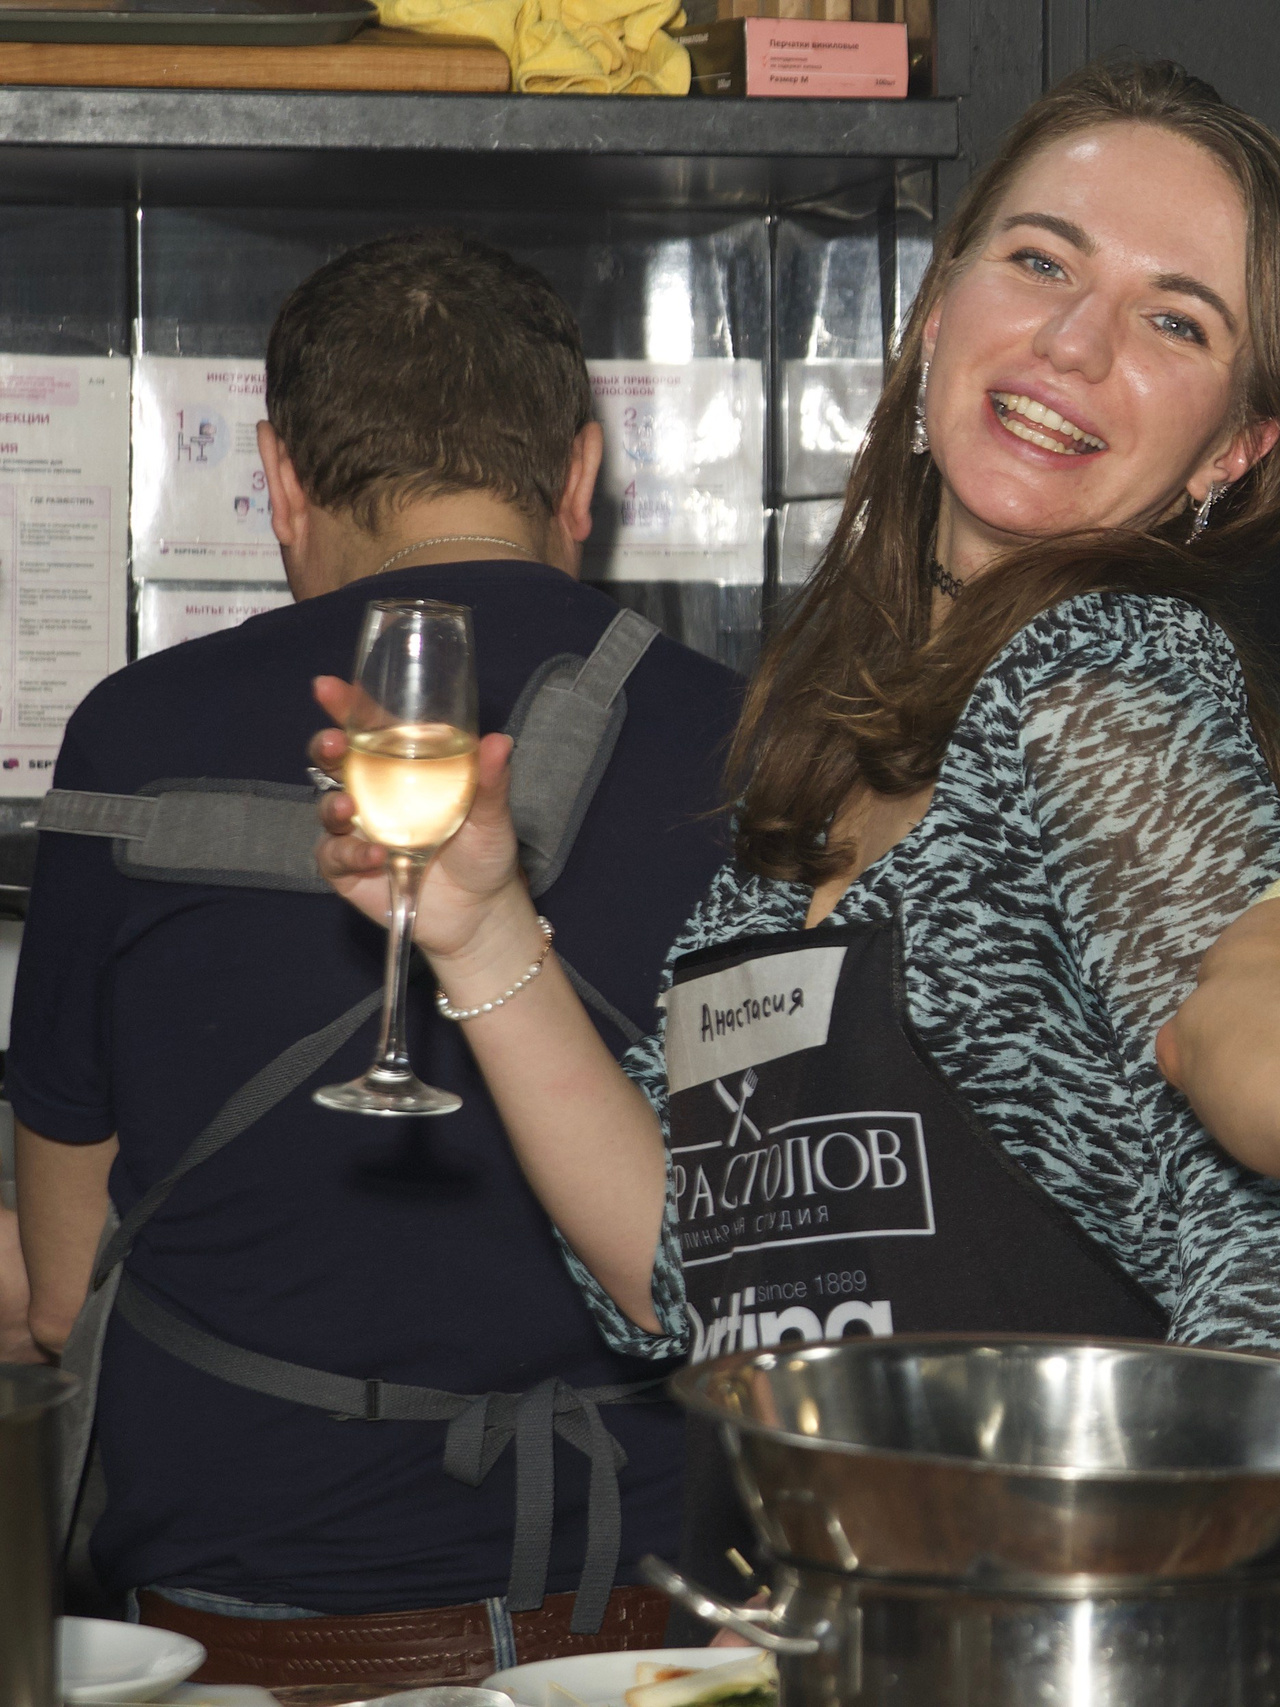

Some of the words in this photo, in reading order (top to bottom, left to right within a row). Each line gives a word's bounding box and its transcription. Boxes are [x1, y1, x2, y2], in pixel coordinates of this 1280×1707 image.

[769, 39, 810, 51] Перчатки
[811, 42, 860, 50] виниловые
[769, 75, 799, 85] Размер
[206, 372, 267, 383] ИНСТРУКЦ
[623, 376, 681, 385] ПРИБОРОВ
[228, 384, 266, 394] ОБЕДЕ
[701, 987, 804, 1043] Анастасия
[720, 1128, 909, 1210] СТОЛОВ
[757, 1280, 807, 1302] since
[814, 1269, 867, 1295] 1889
